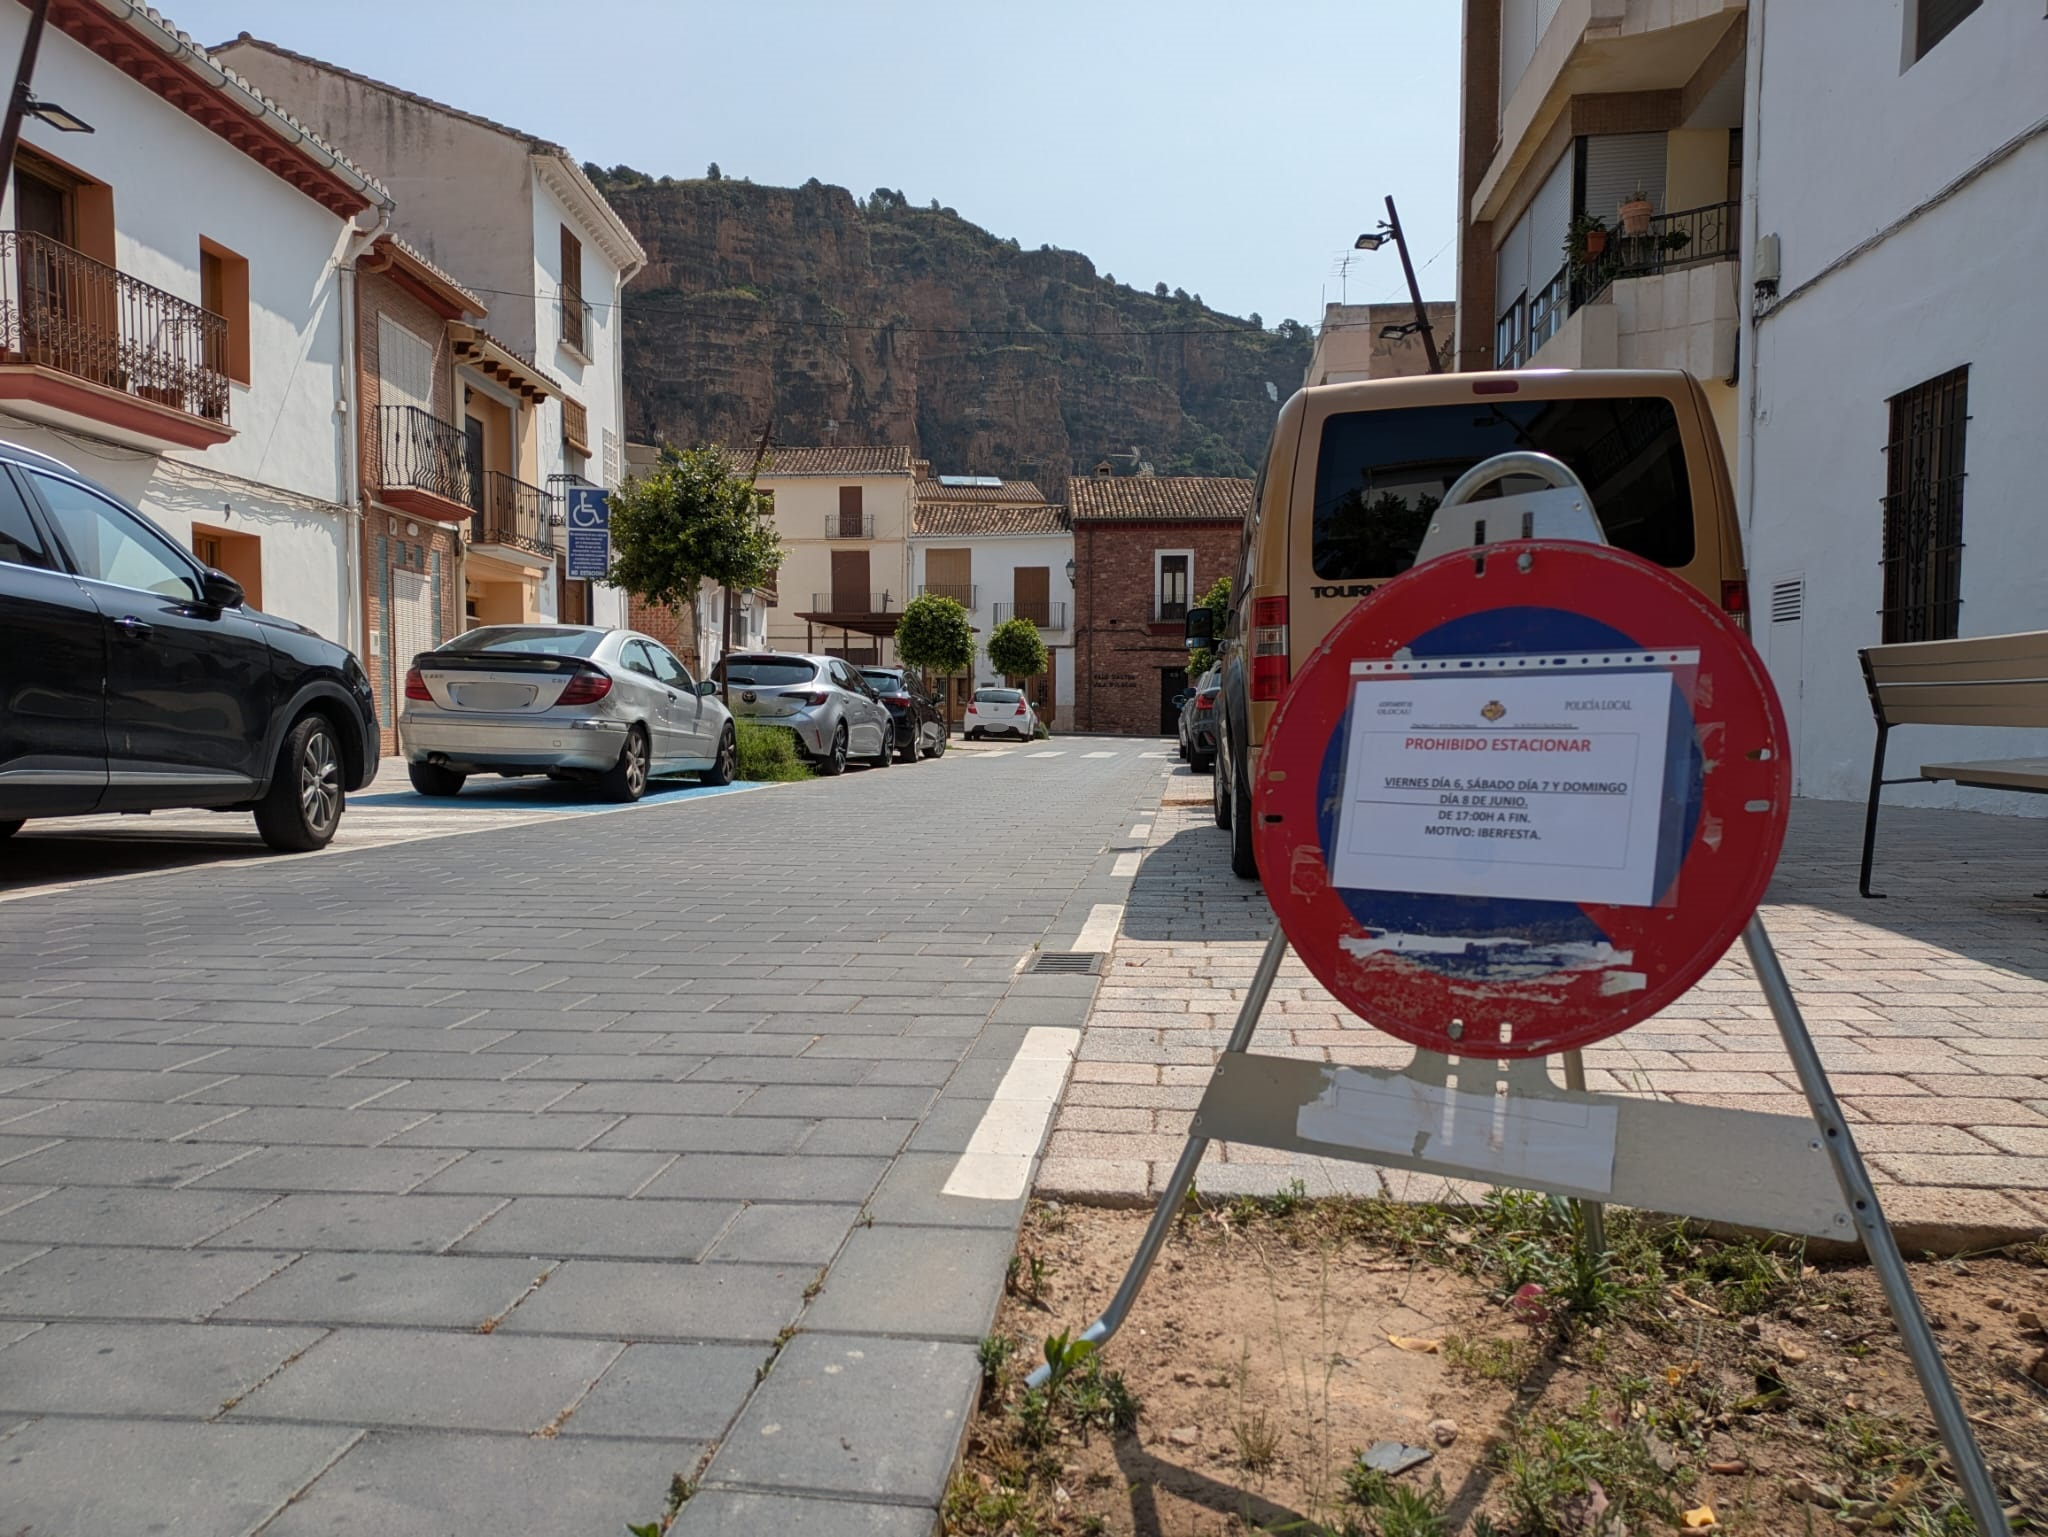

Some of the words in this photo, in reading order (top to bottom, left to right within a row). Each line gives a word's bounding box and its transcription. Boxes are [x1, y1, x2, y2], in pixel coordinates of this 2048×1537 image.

[1601, 699, 1632, 712] LOCAL
[1405, 737, 1487, 751] PROHIBIDO
[1492, 738, 1591, 753] ESTACIONAR
[1385, 777, 1429, 788] VIERNES
[1431, 776, 1451, 789] DÍA
[1453, 779, 1464, 791] 6,
[1467, 777, 1515, 790] SÁBADO
[1518, 778, 1539, 791] DÍA
[1541, 781, 1550, 791] 7
[1552, 781, 1561, 791] Y
[1563, 782, 1628, 793] DOMINGO
[1440, 793, 1459, 805] DÍA
[1462, 795, 1469, 805] 8
[1472, 796, 1487, 805] DE
[1489, 796, 1529, 807] JUNIO.
[1438, 810, 1453, 820] DE
[1456, 811, 1494, 822] 17:00H
[1497, 812, 1506, 822] A
[1508, 813, 1532, 823] FIN.
[1424, 825, 1475, 838] MOTIVO:
[1478, 828, 1542, 840] IBERFESTA.
